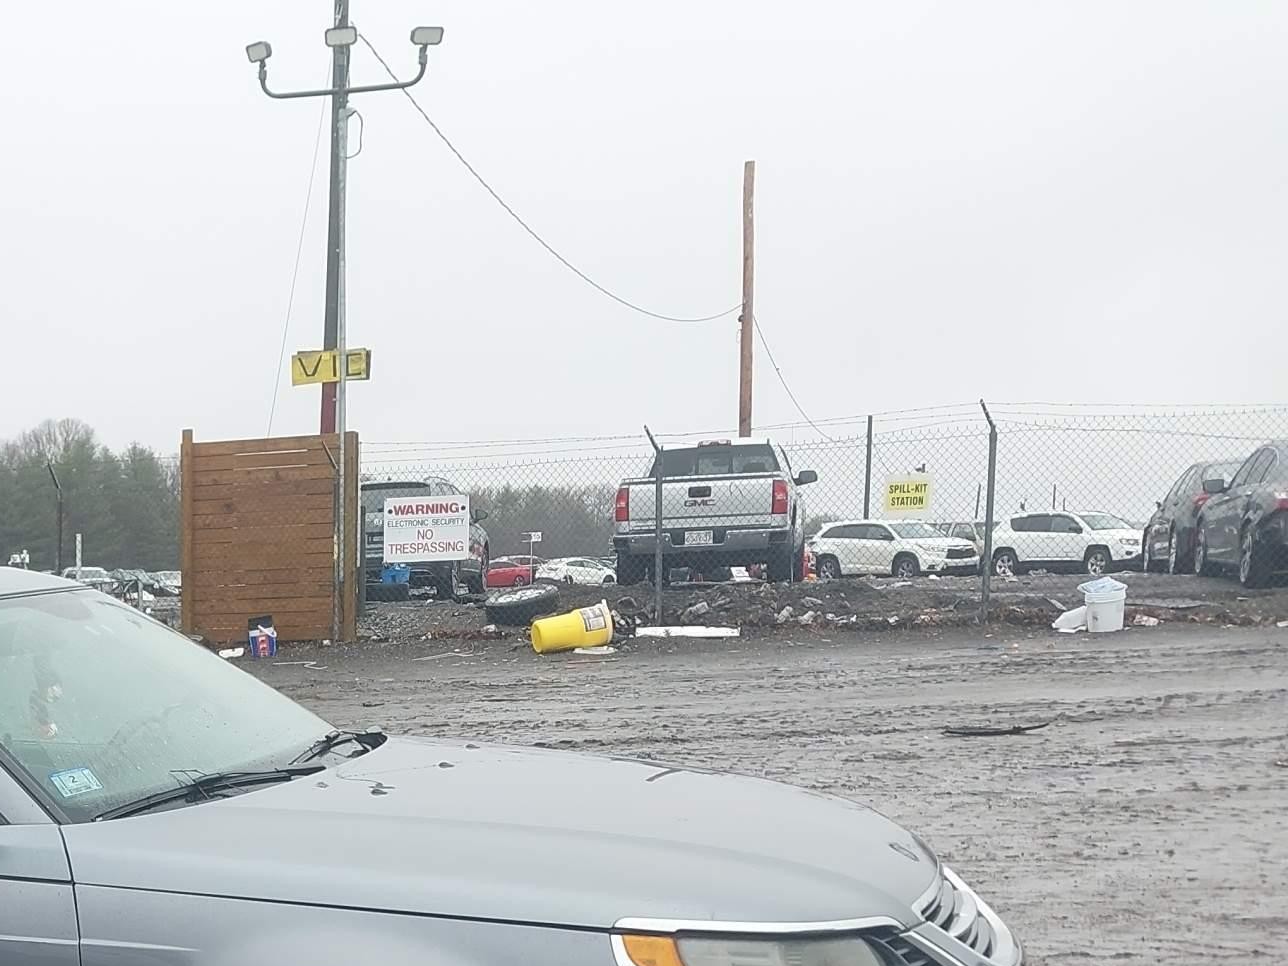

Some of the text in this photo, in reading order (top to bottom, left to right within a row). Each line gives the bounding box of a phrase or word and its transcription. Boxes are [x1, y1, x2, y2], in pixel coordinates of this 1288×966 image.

[888, 483, 928, 494] SPILL-KIT
[684, 499, 716, 507] GMC
[890, 496, 924, 506] STATION
[393, 502, 459, 516] WARNING
[387, 517, 464, 528] ELECTRONIC SECURITY
[417, 529, 433, 540] NO
[388, 541, 464, 554] TRESPASSING
[68, 775, 78, 783] 2
